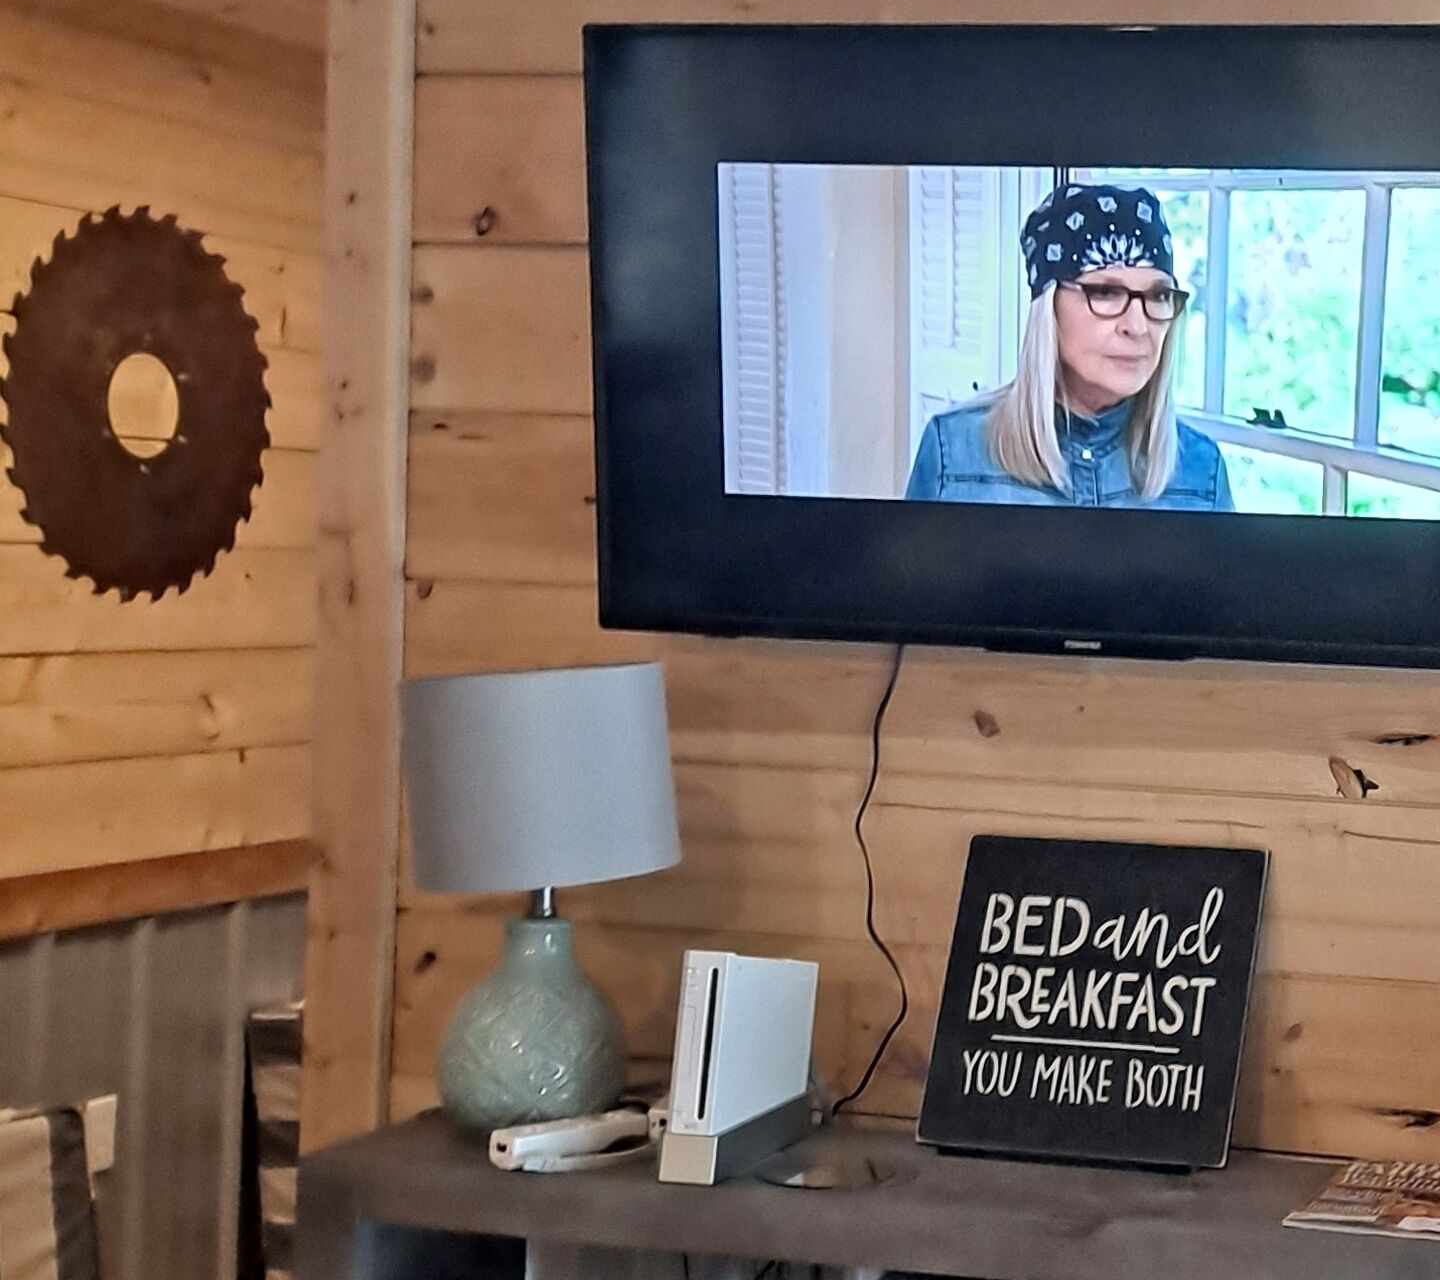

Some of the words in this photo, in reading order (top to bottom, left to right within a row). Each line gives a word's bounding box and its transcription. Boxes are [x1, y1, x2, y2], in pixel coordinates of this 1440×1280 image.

[980, 894, 1089, 956] BED
[1094, 887, 1223, 968] and
[968, 962, 1217, 1037] BREAKFAST
[964, 1048, 1022, 1096] YOU
[1031, 1055, 1112, 1104] MAKE
[1126, 1059, 1203, 1110] BOTH
